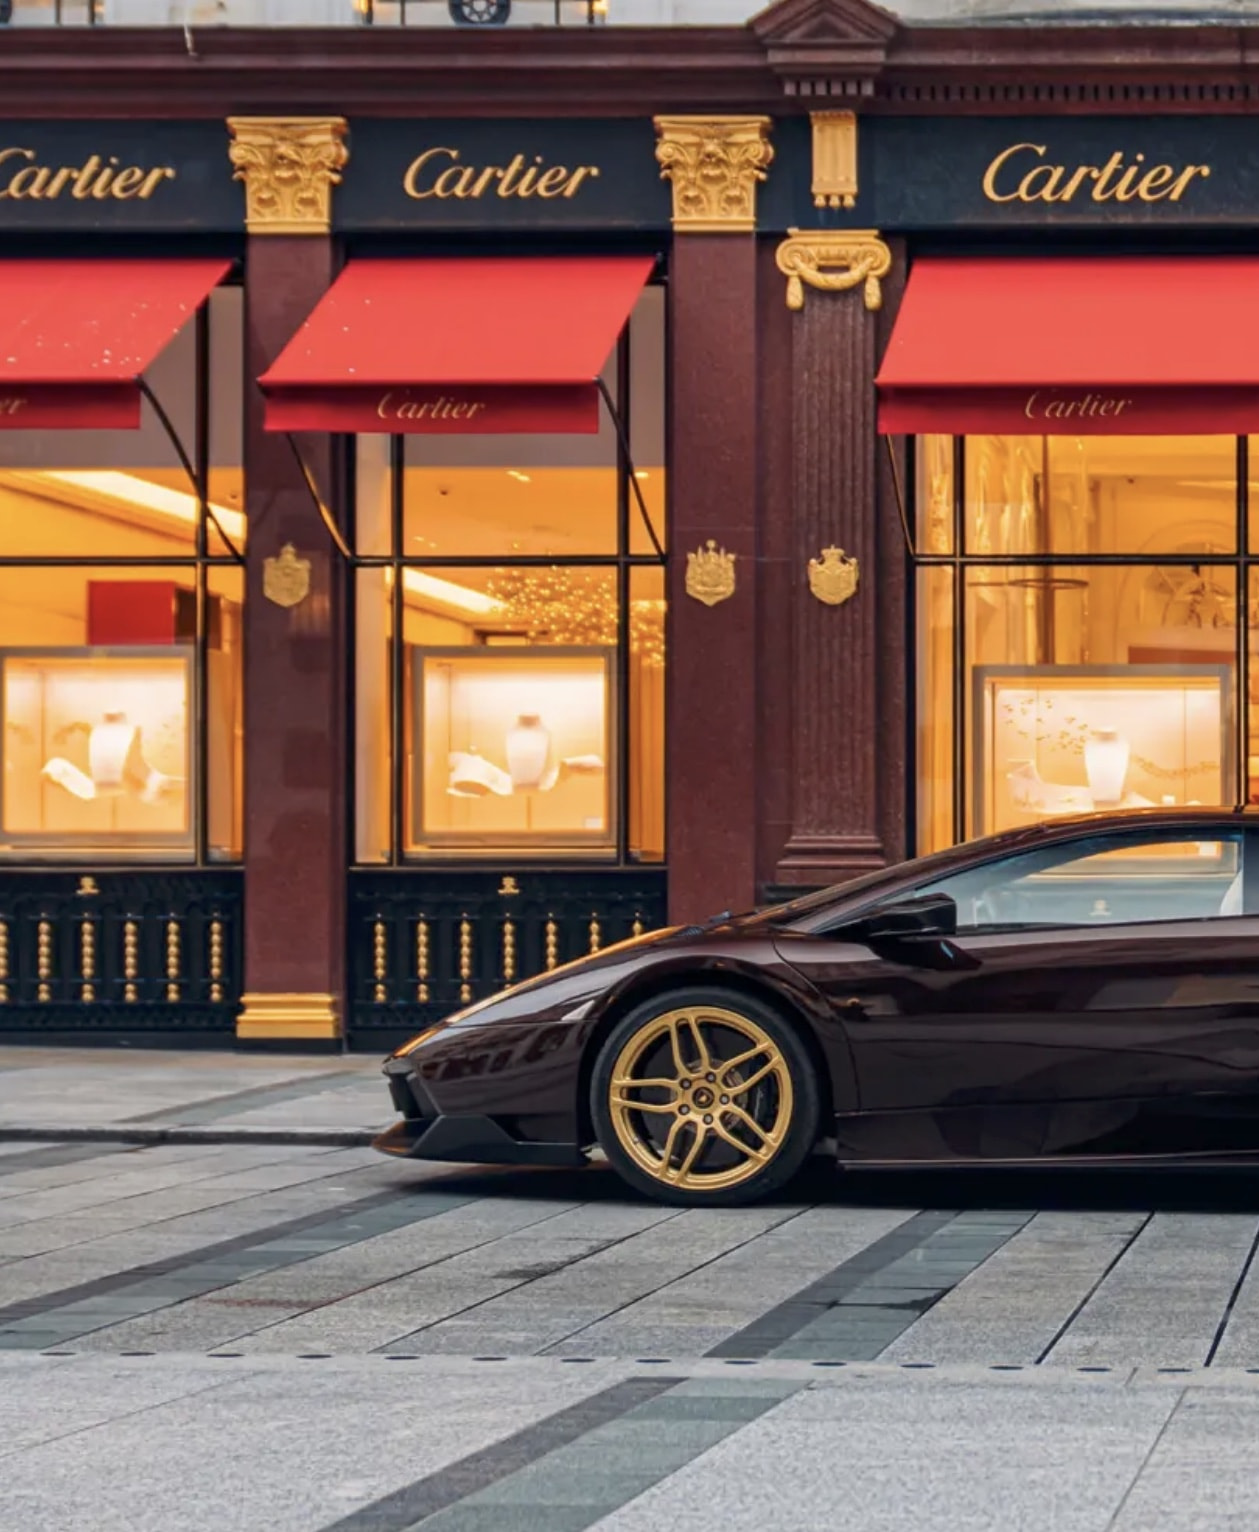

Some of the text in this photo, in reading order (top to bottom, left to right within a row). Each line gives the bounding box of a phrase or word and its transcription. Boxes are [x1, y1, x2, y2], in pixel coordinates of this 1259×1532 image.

[403, 147, 600, 201] Cartier
[982, 143, 1211, 204] Cartier
[377, 389, 486, 419] Cartier
[1024, 388, 1133, 419] Cartier
